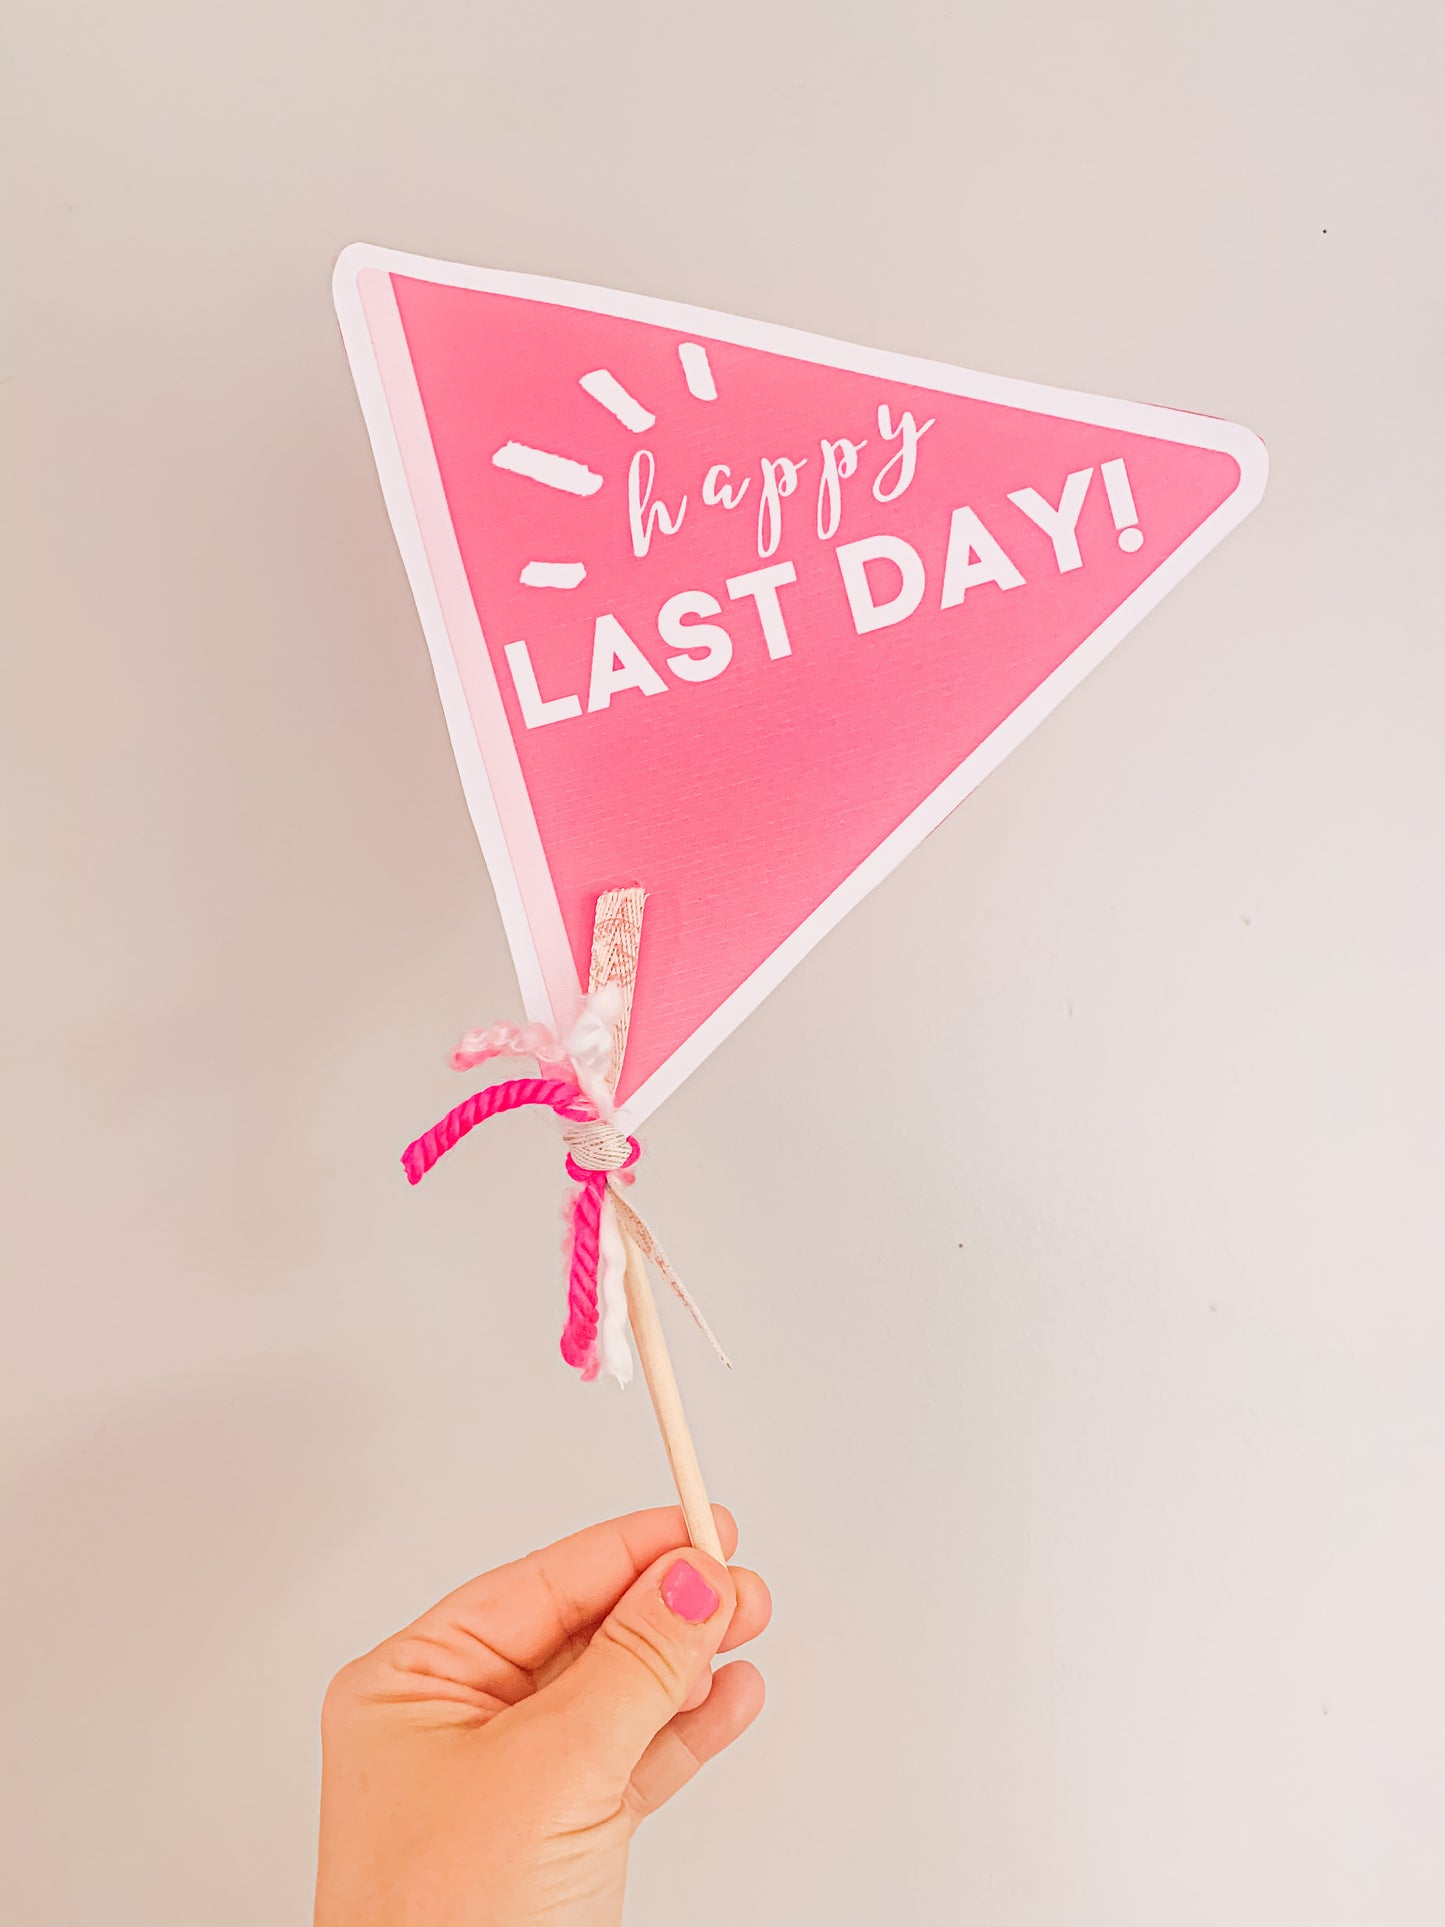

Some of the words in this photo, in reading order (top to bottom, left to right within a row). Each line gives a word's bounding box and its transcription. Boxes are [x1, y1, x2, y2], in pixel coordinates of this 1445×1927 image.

[628, 404, 936, 558] happy
[503, 561, 797, 730] LAST
[835, 457, 1144, 635] DAY!
